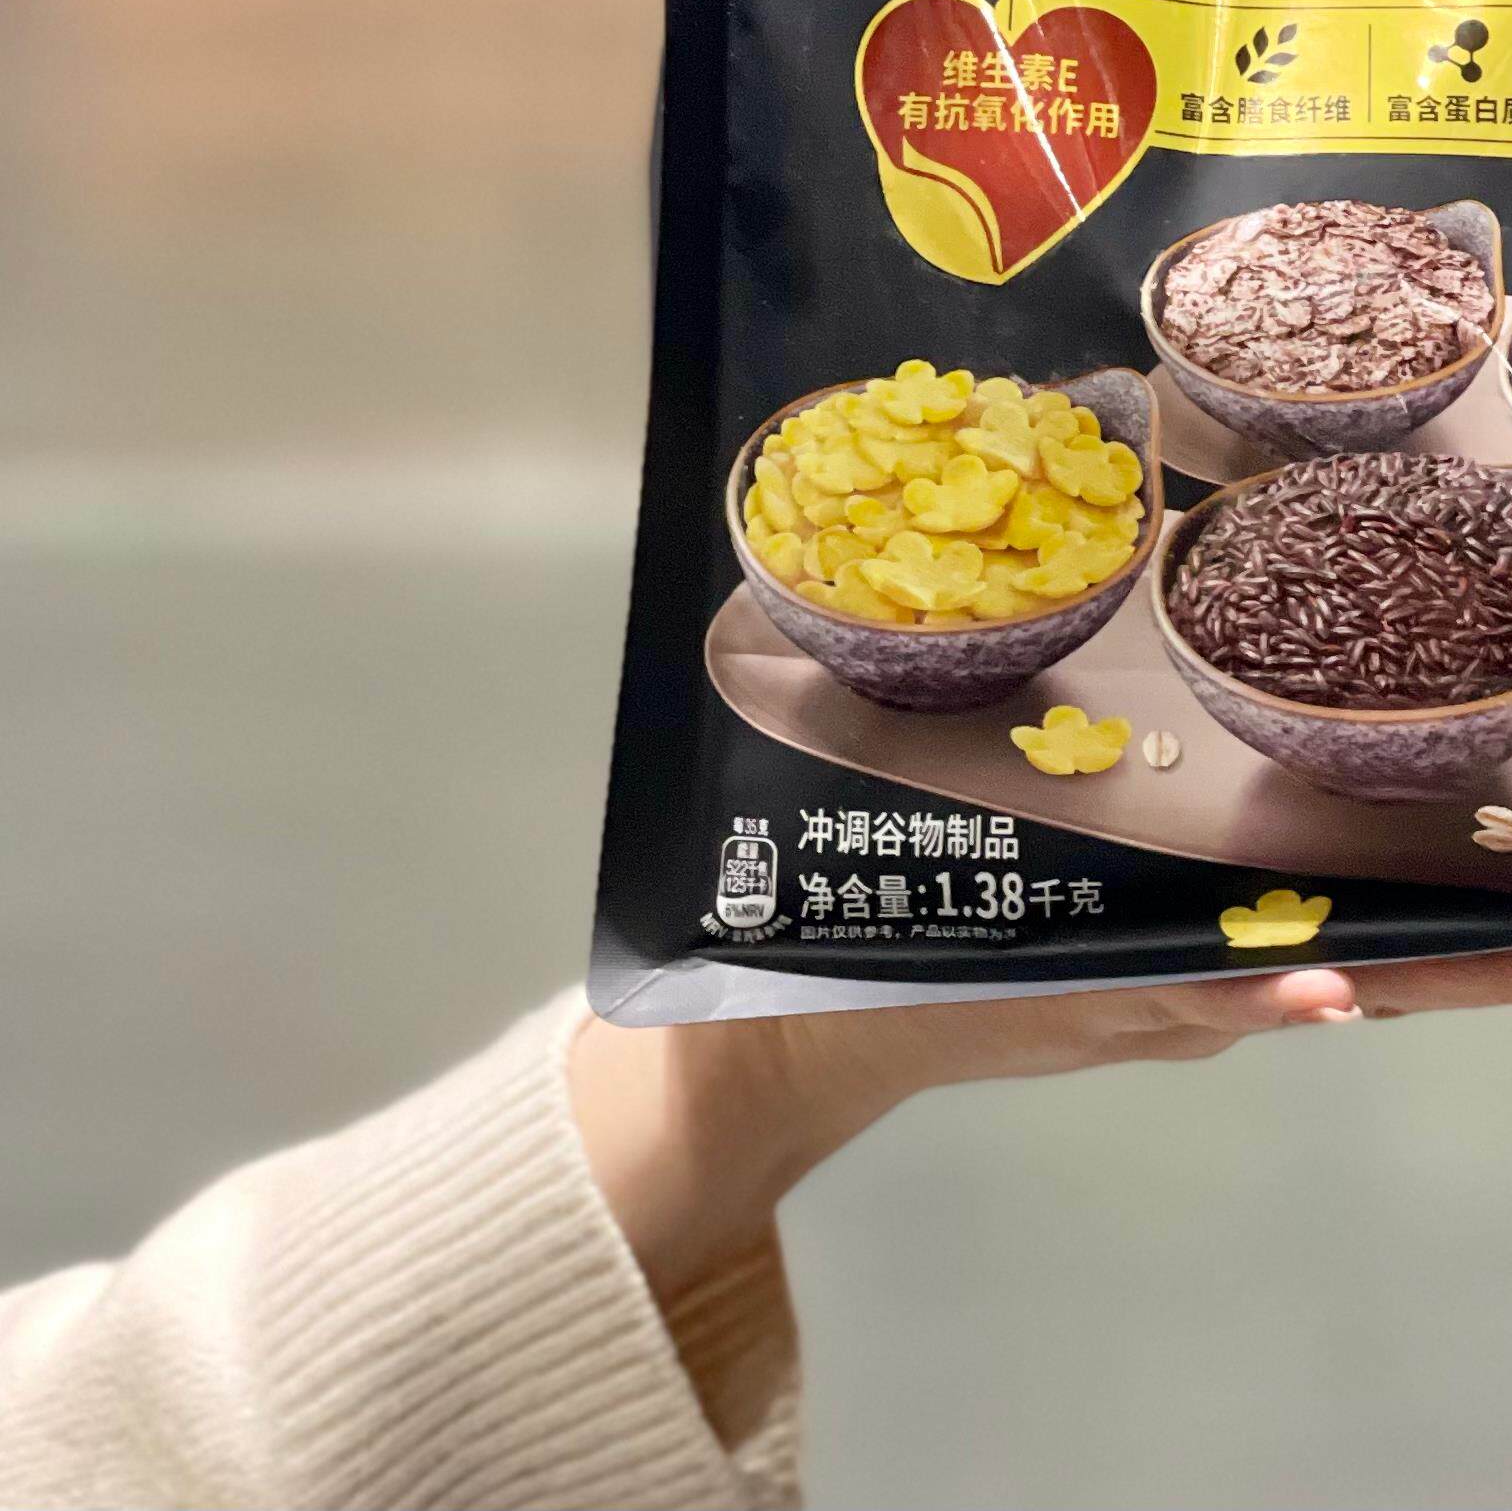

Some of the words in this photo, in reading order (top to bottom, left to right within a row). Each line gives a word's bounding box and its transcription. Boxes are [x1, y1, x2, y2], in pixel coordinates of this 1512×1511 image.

[943, 50, 1078, 93] 维生素E
[898, 92, 1120, 138] 有抗氧化作用
[1181, 92, 1351, 124] 富含膳食纤维
[798, 808, 1019, 860] 冲调谷物制品
